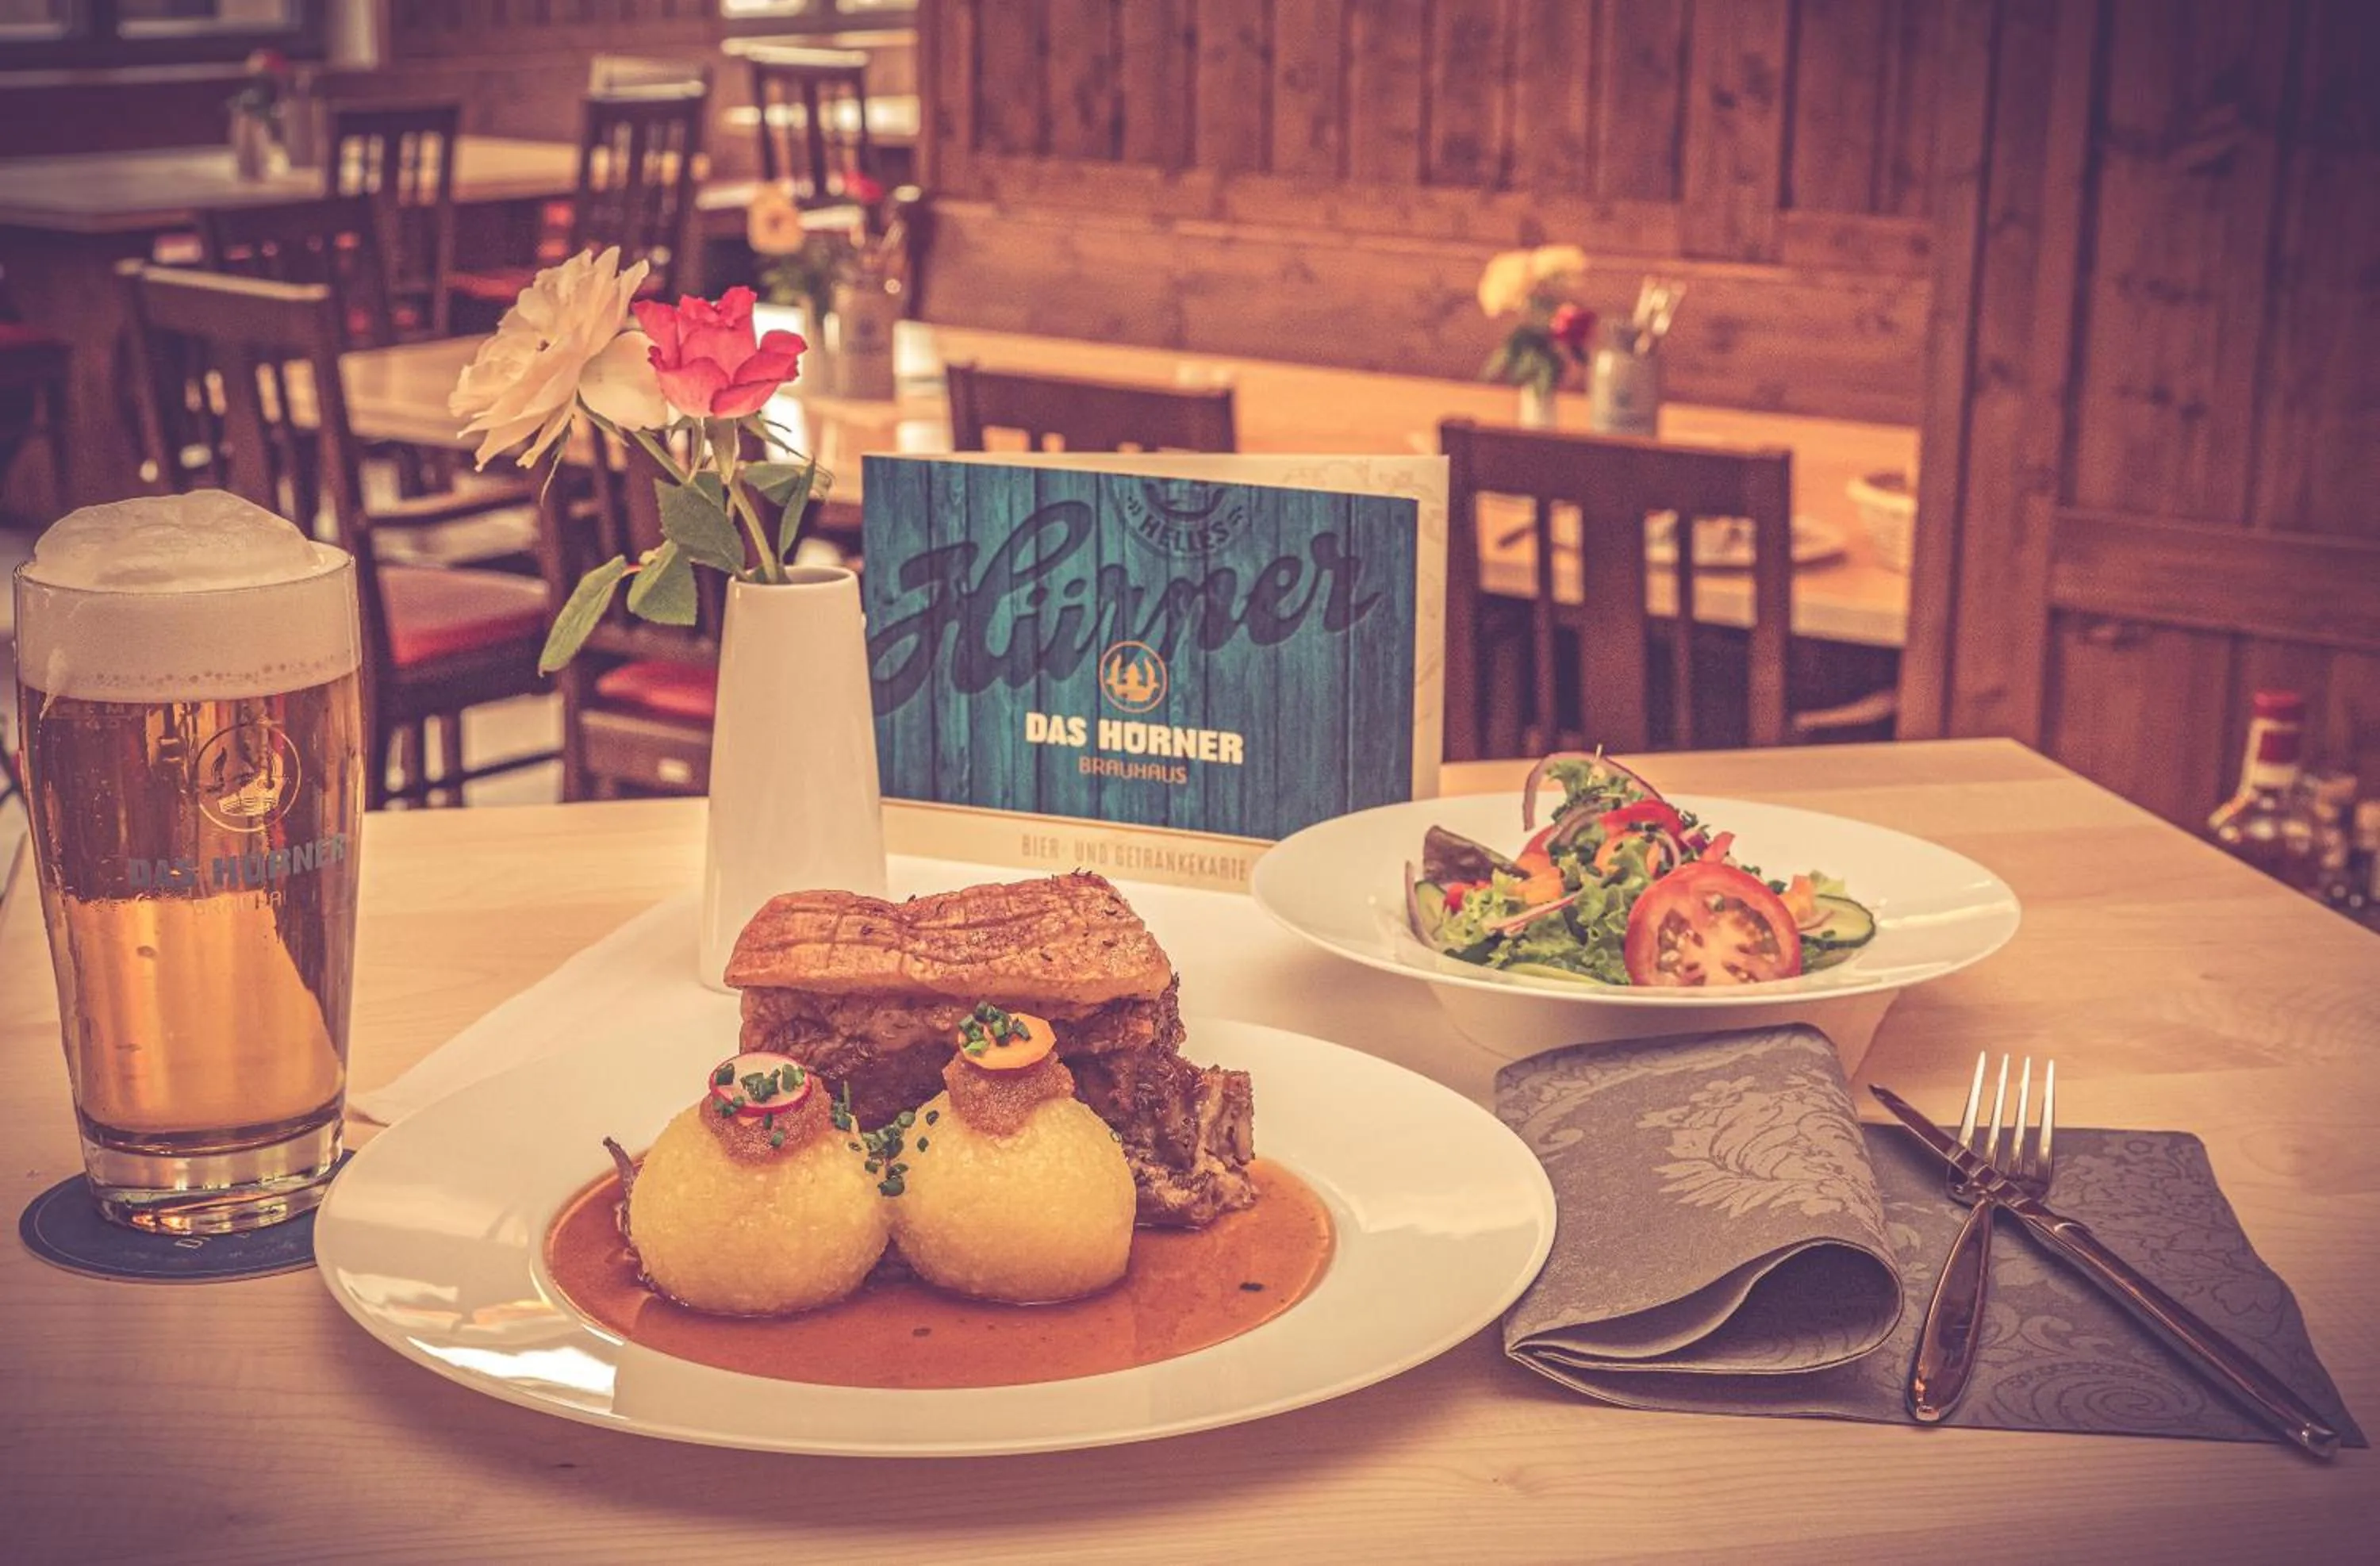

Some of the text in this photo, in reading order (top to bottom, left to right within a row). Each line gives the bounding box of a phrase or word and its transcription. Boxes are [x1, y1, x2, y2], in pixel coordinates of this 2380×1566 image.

[1138, 514, 1230, 555] HELLES
[1025, 712, 1087, 747] DAS
[1079, 756, 1187, 784] BRAUHAUS
[1075, 839, 1108, 866] UND
[129, 857, 195, 888] DAS
